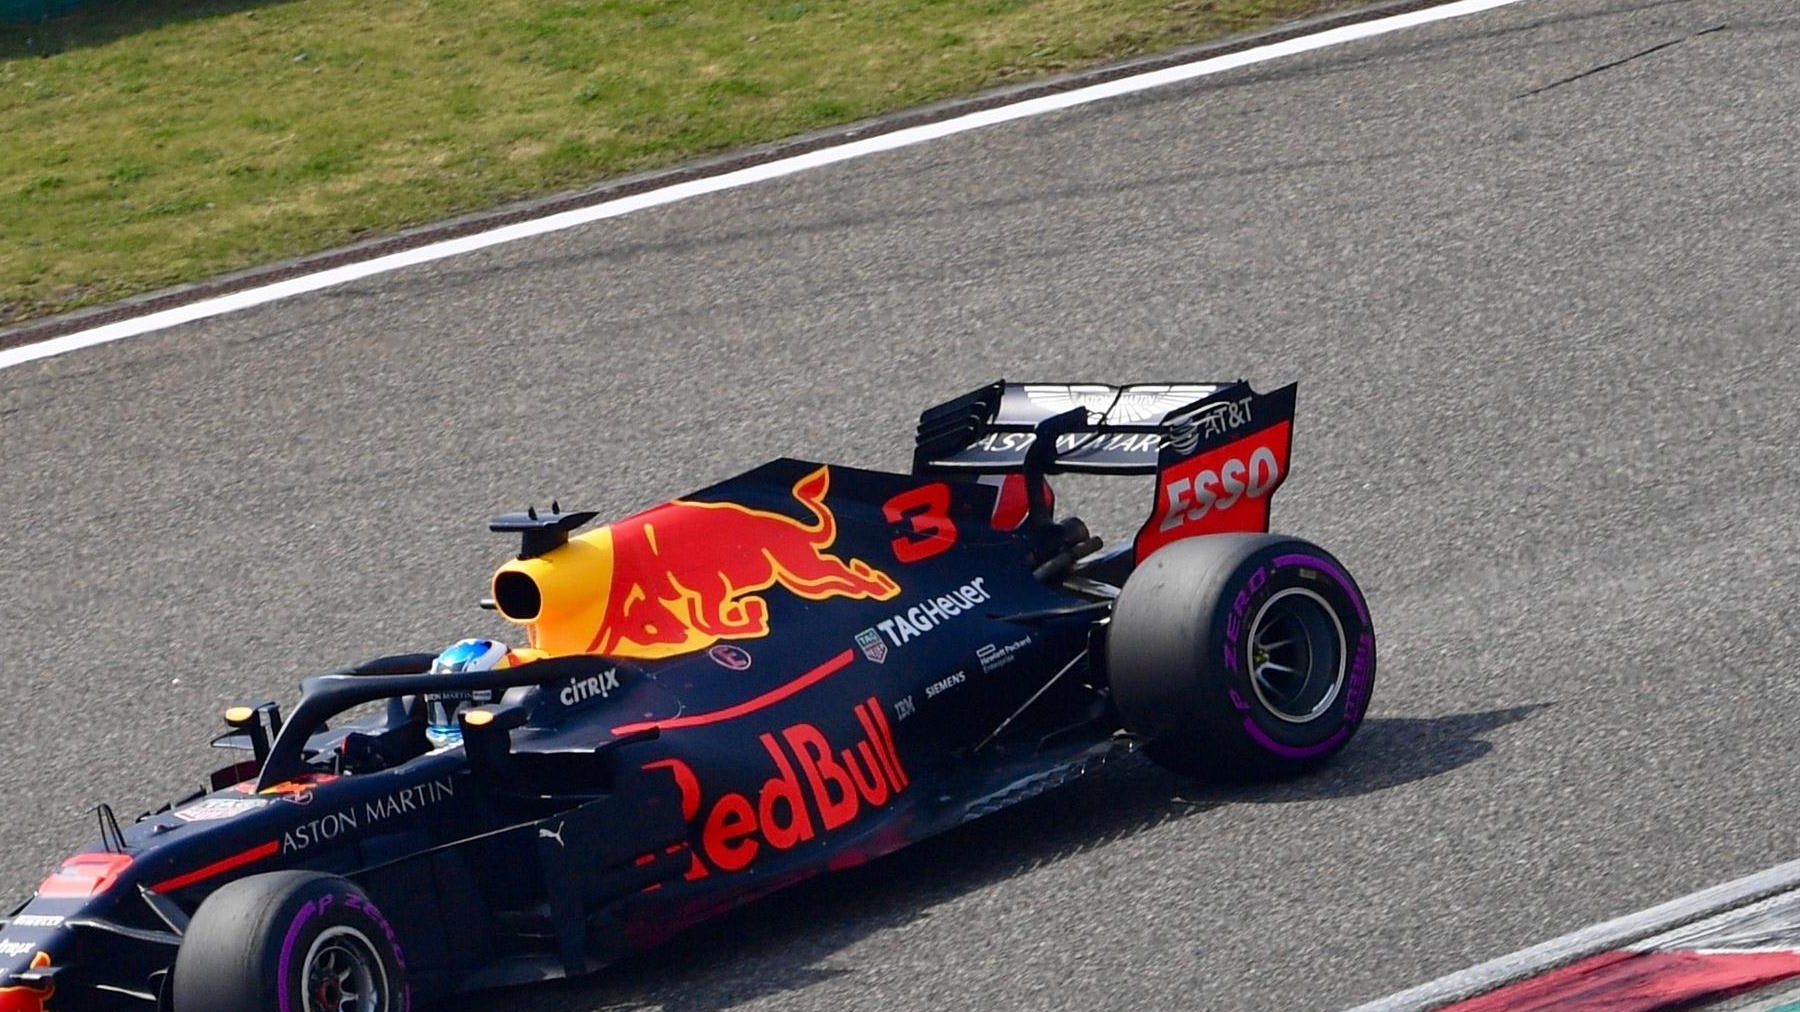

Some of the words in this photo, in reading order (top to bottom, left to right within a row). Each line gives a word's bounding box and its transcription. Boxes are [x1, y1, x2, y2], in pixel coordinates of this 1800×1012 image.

[1204, 397, 1253, 440] AT&T
[882, 482, 957, 564] 3
[1159, 446, 1279, 532] ESSO
[925, 670, 966, 699] SIEMENS
[282, 806, 358, 855] ASTON
[364, 775, 455, 825] MARTIN
